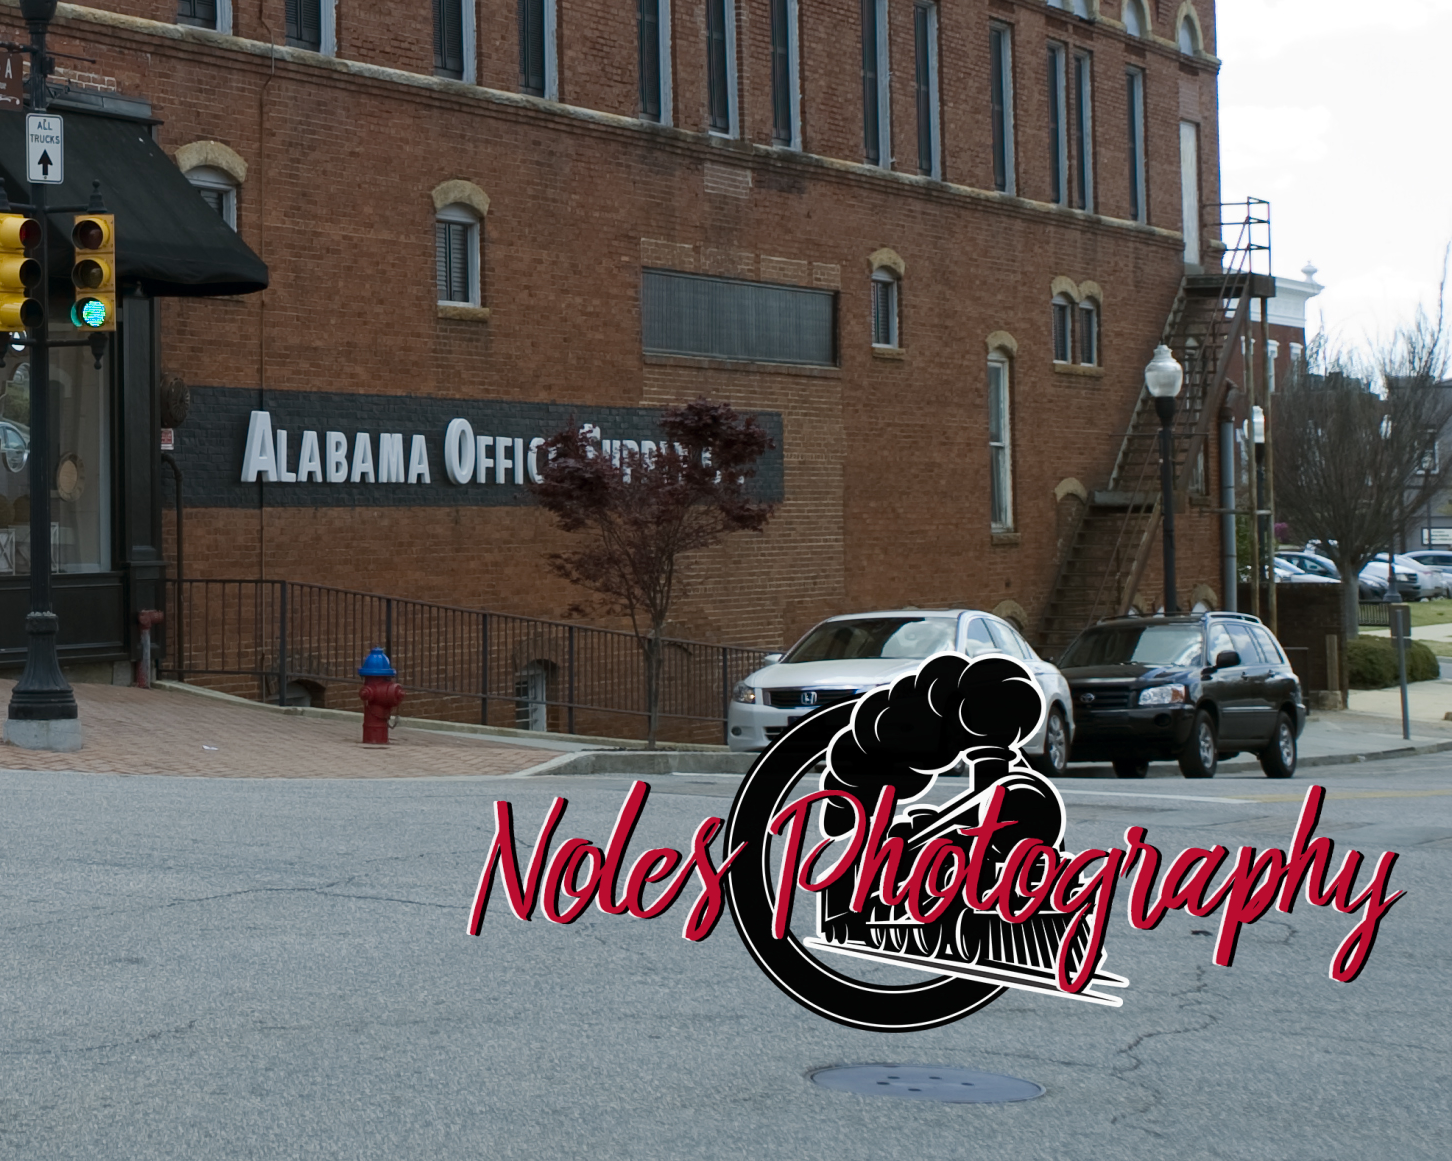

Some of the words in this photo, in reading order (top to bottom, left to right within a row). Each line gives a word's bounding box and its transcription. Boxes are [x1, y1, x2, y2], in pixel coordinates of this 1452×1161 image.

[4, 57, 13, 79] A
[37, 121, 53, 131] ALL
[30, 134, 60, 144] TRUCKS
[240, 410, 432, 484] ALABAMA
[444, 417, 561, 486] OFFIC
